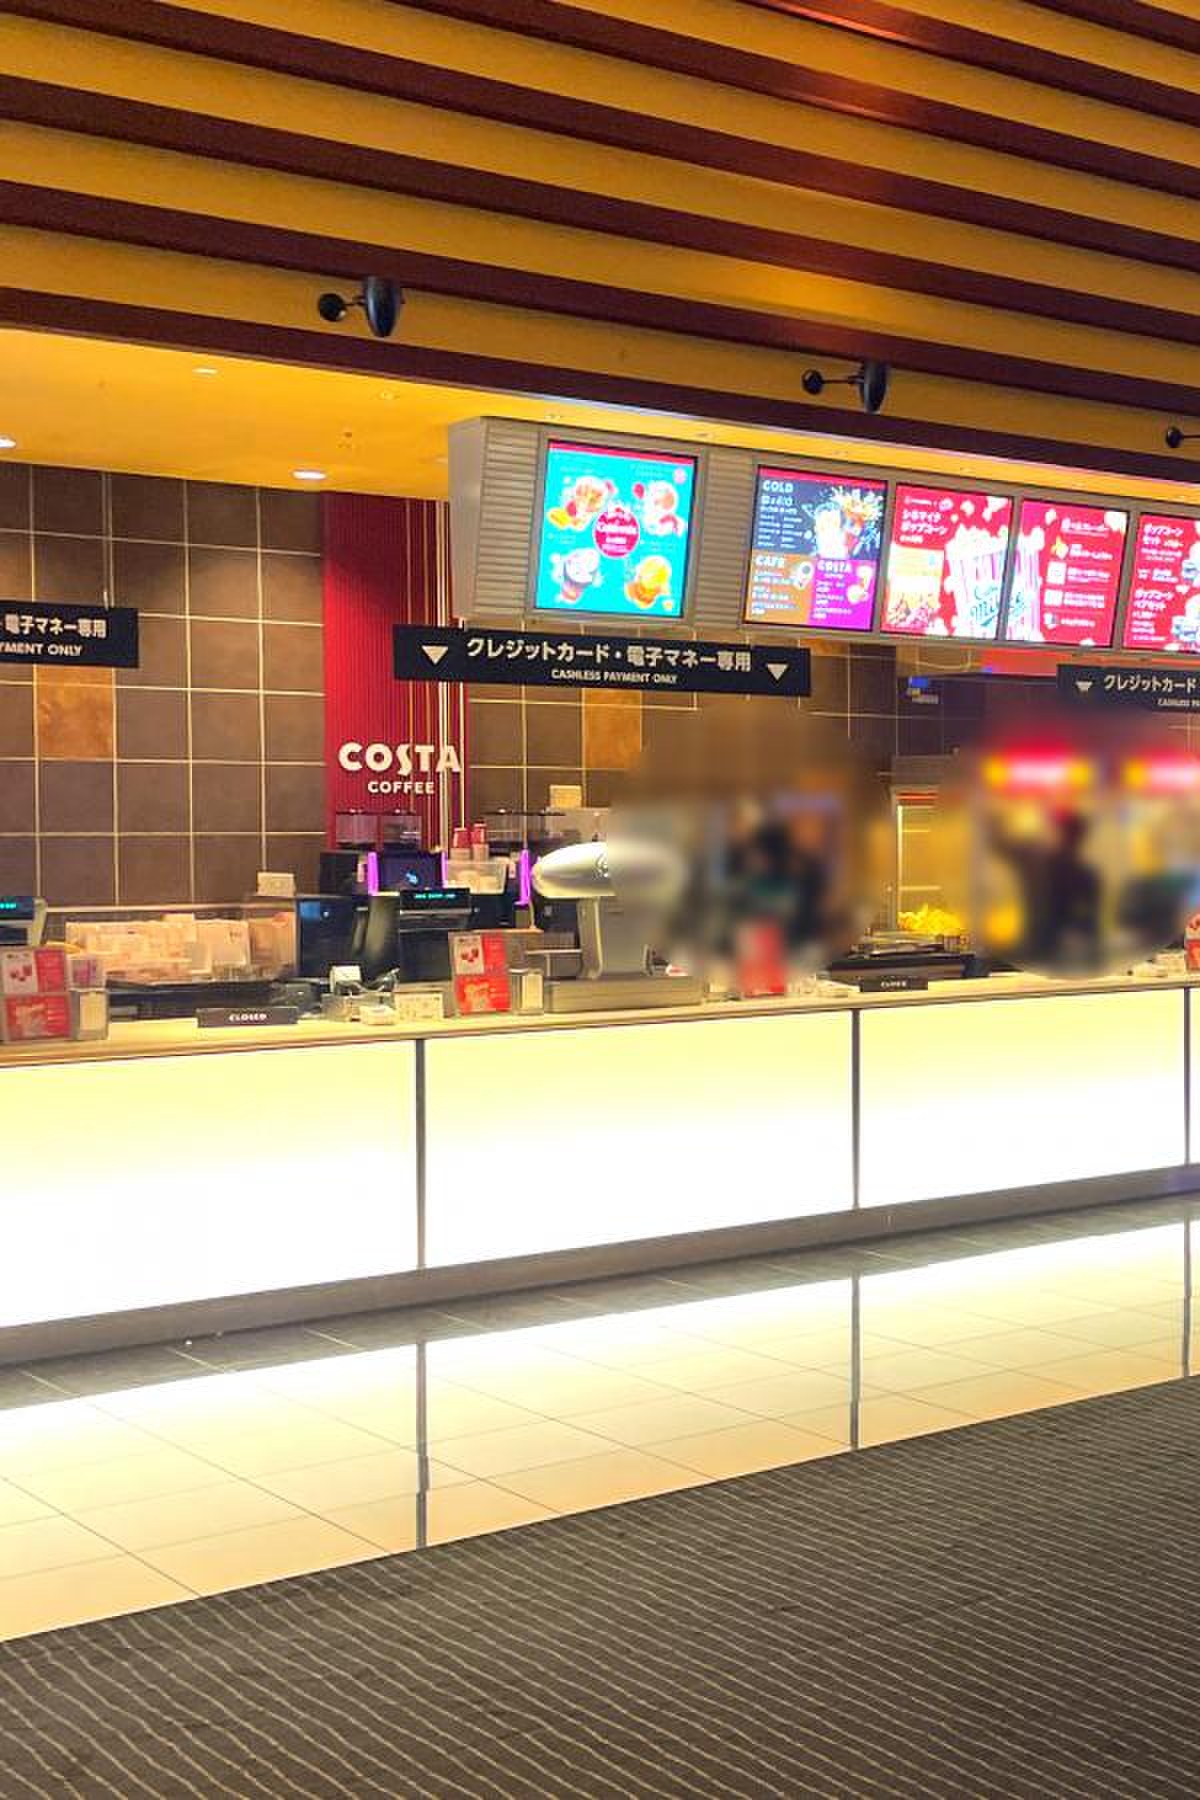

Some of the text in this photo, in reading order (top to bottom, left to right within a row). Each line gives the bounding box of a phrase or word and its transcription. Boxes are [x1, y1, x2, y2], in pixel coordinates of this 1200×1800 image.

[762, 480, 794, 493] COLD
[47, 643, 82, 656] ONLY
[466, 638, 752, 673] クレジットカード・電子マネー専用
[551, 669, 678, 684] CASHLESS PAYMENT ONLY
[338, 742, 461, 776] COSTA
[367, 781, 434, 794] COFFEE
